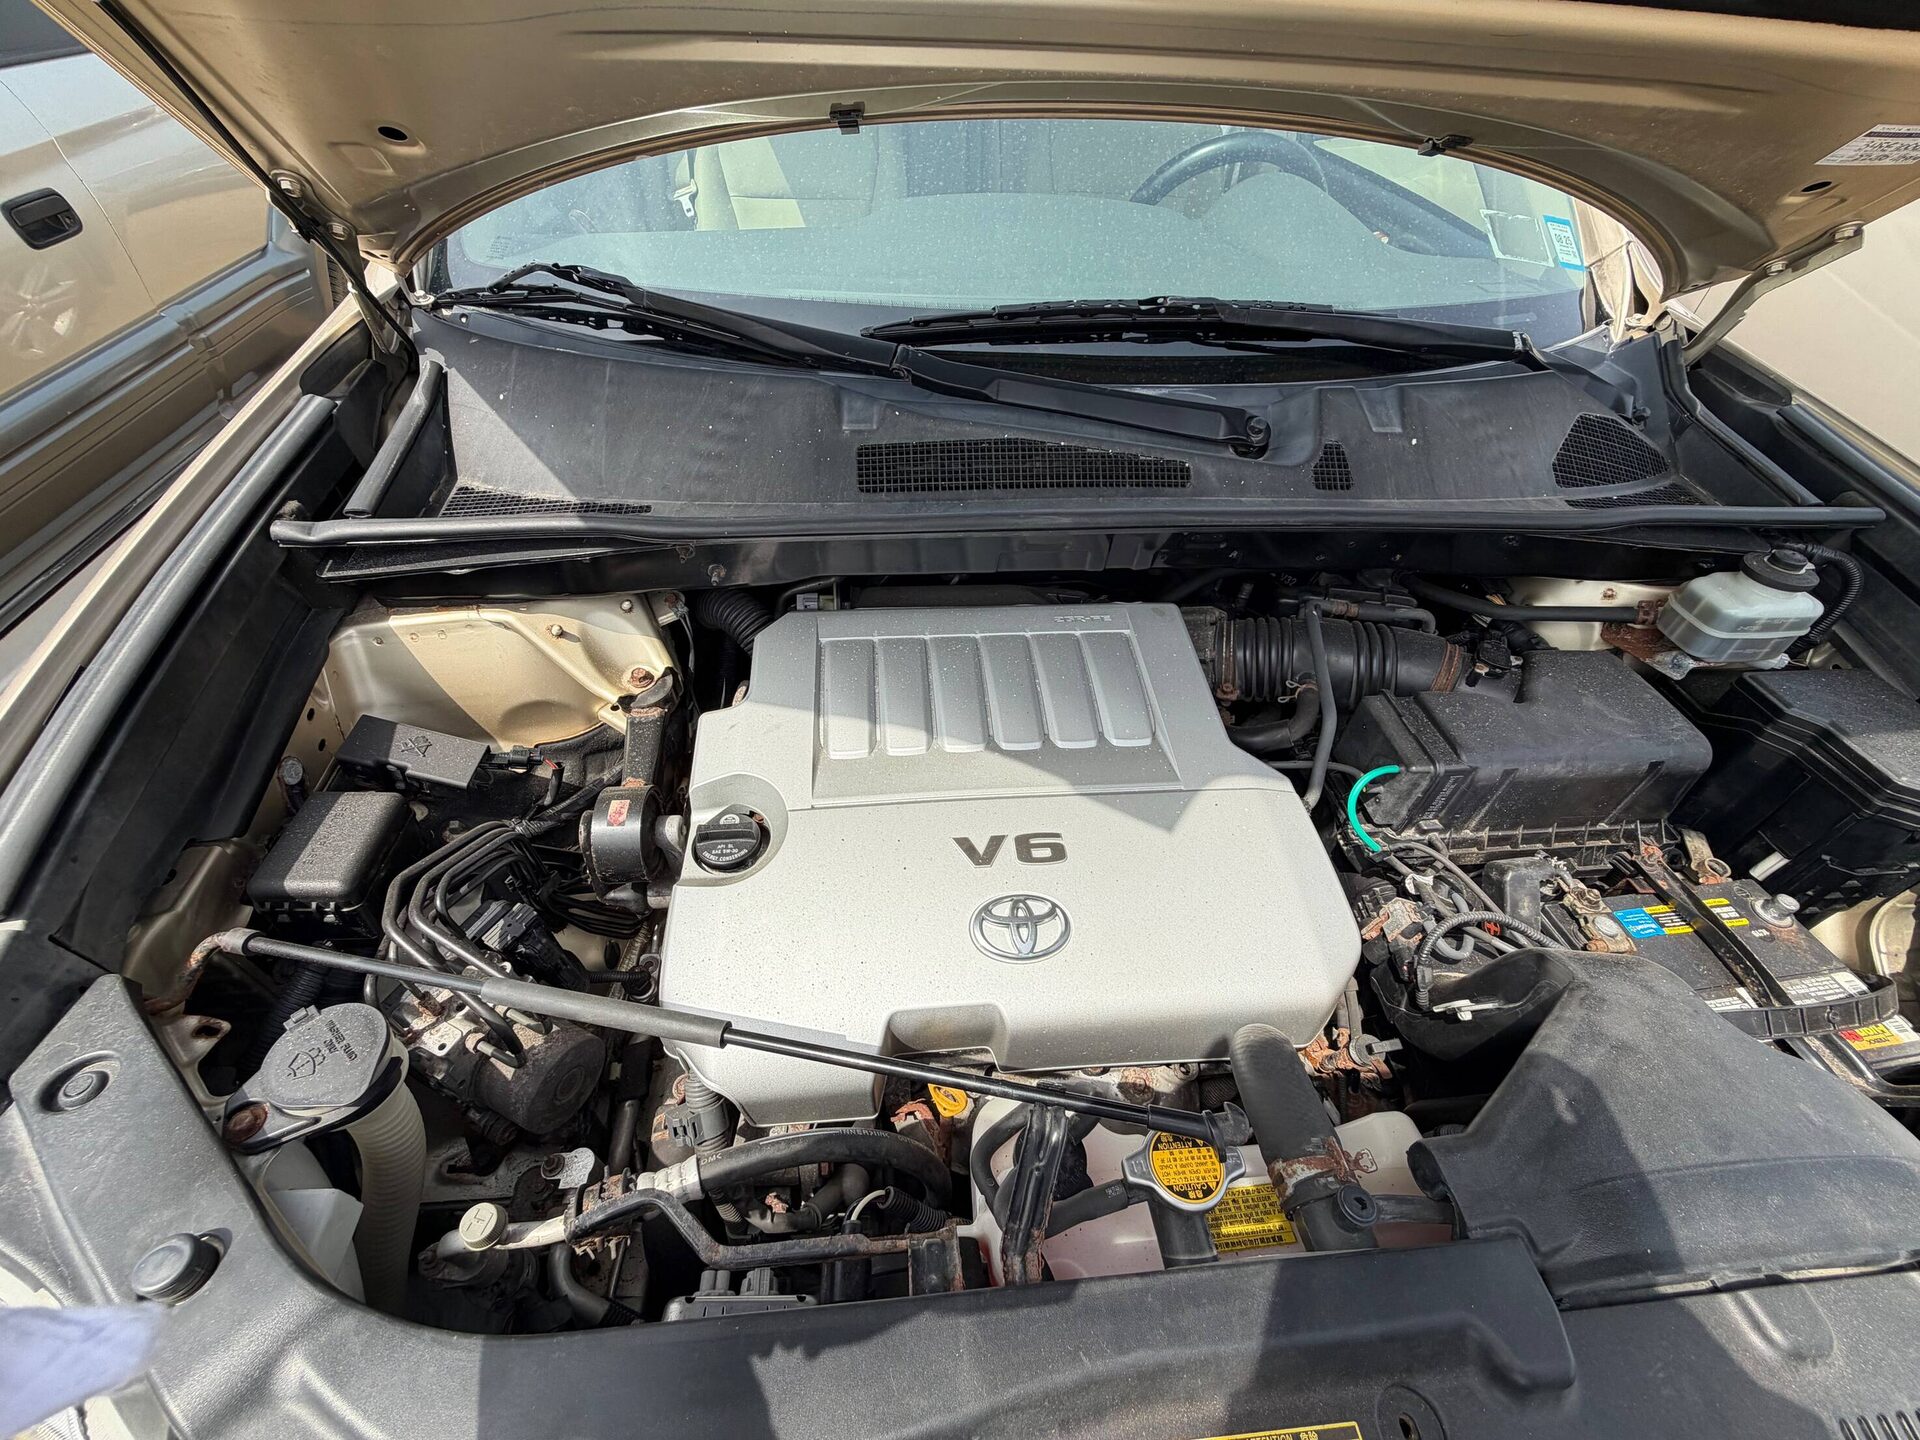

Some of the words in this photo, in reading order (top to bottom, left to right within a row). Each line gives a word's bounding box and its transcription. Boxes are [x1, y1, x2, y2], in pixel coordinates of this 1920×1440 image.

[951, 832, 1069, 868] V6
[1157, 1140, 1193, 1150] ATTENTION
[1172, 1182, 1208, 1192] CAUTION
